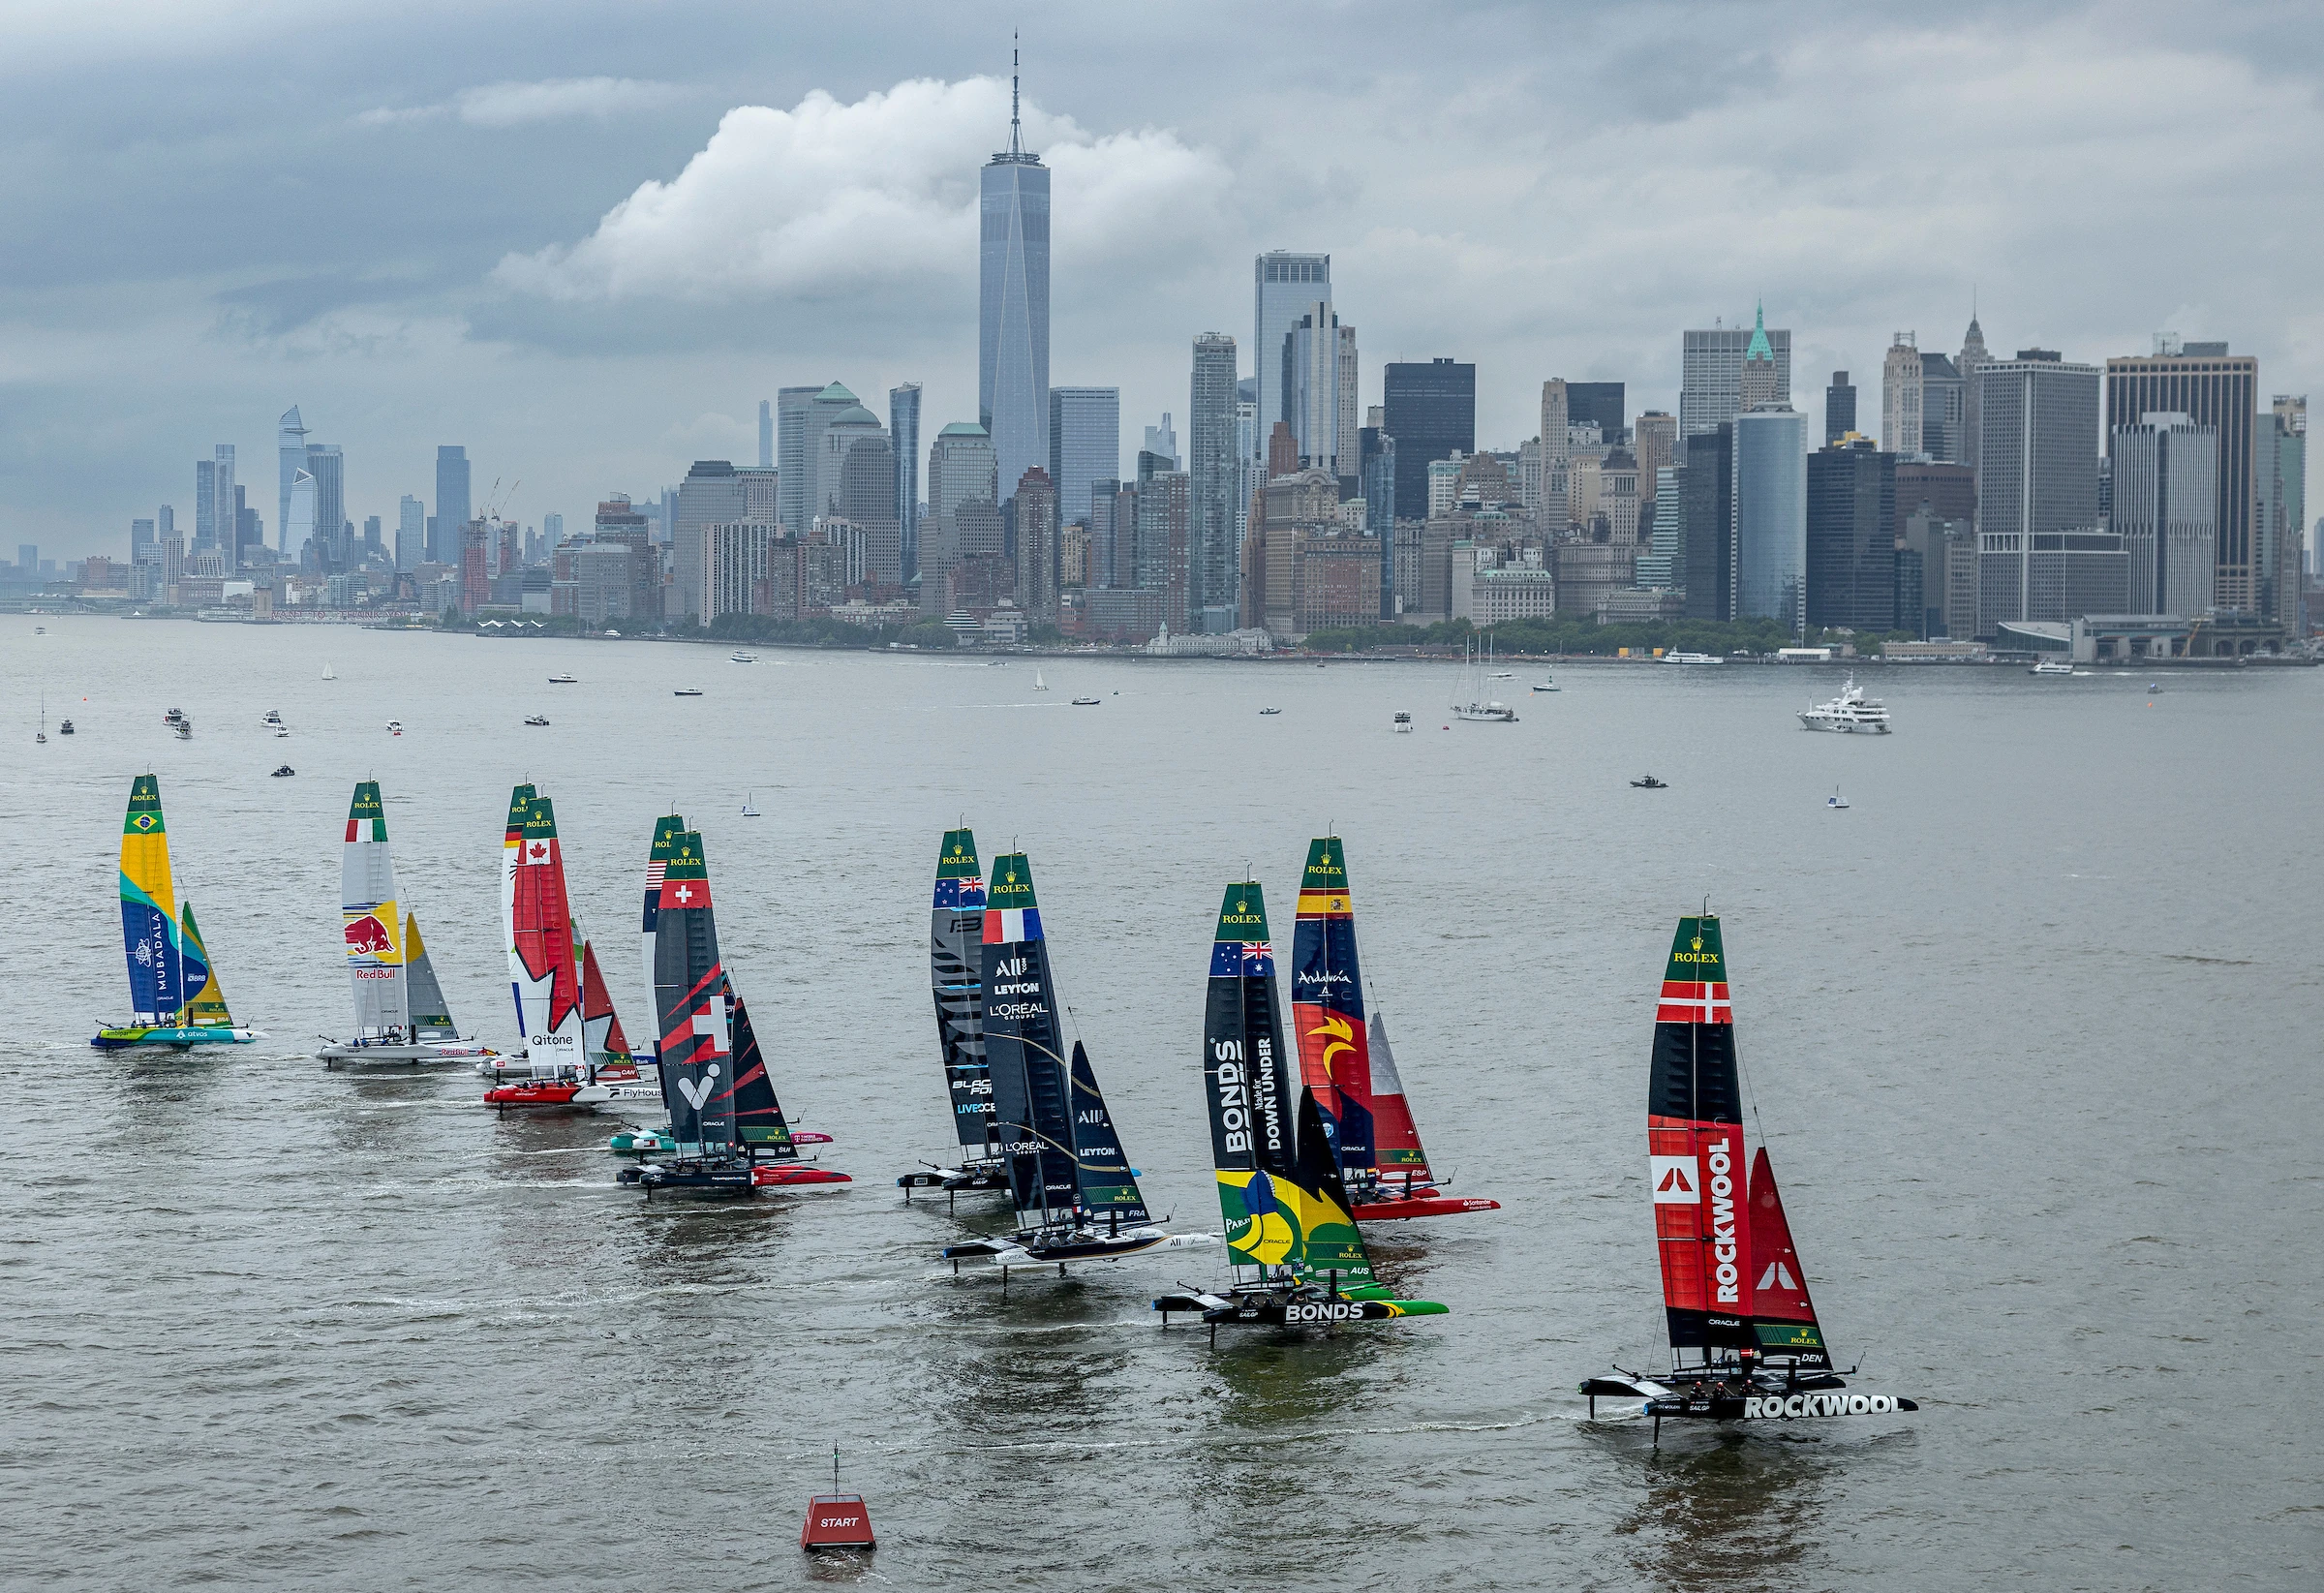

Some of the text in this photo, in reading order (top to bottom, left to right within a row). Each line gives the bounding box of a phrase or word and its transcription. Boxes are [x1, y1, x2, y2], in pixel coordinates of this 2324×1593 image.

[526, 819, 552, 828] ROLEX
[942, 855, 974, 865] ROLEX
[1308, 866, 1342, 874] ROLEX
[993, 883, 1030, 894] ROLEX
[1222, 914, 1262, 924] ROLEX
[152, 913, 167, 991] MUBADALA
[1674, 952, 1719, 964] ROLEX
[356, 968, 395, 979] Red Bull
[994, 982, 1040, 996] LEYTON
[990, 1001, 1049, 1016] L'ORÉAL
[532, 1034, 573, 1046] Qitone
[1258, 1037, 1275, 1093] UNDER
[952, 1079, 993, 1089] BLAC
[624, 1088, 663, 1099] FlyHous
[969, 1087, 993, 1095] FOI
[1215, 1040, 1247, 1153] BONDS
[957, 1102, 996, 1115] LIVEOCE
[1263, 1095, 1281, 1150] DOWN
[1005, 1141, 1050, 1152] L'ORÉAL
[1080, 1147, 1116, 1157] LEYTON
[1708, 1138, 1739, 1302] ROCKWOOL
[1285, 1302, 1364, 1321] BONDS
[1801, 1353, 1823, 1363] DEN
[1744, 1394, 1905, 1419] ROCKWOOL
[820, 1516, 859, 1528] START
